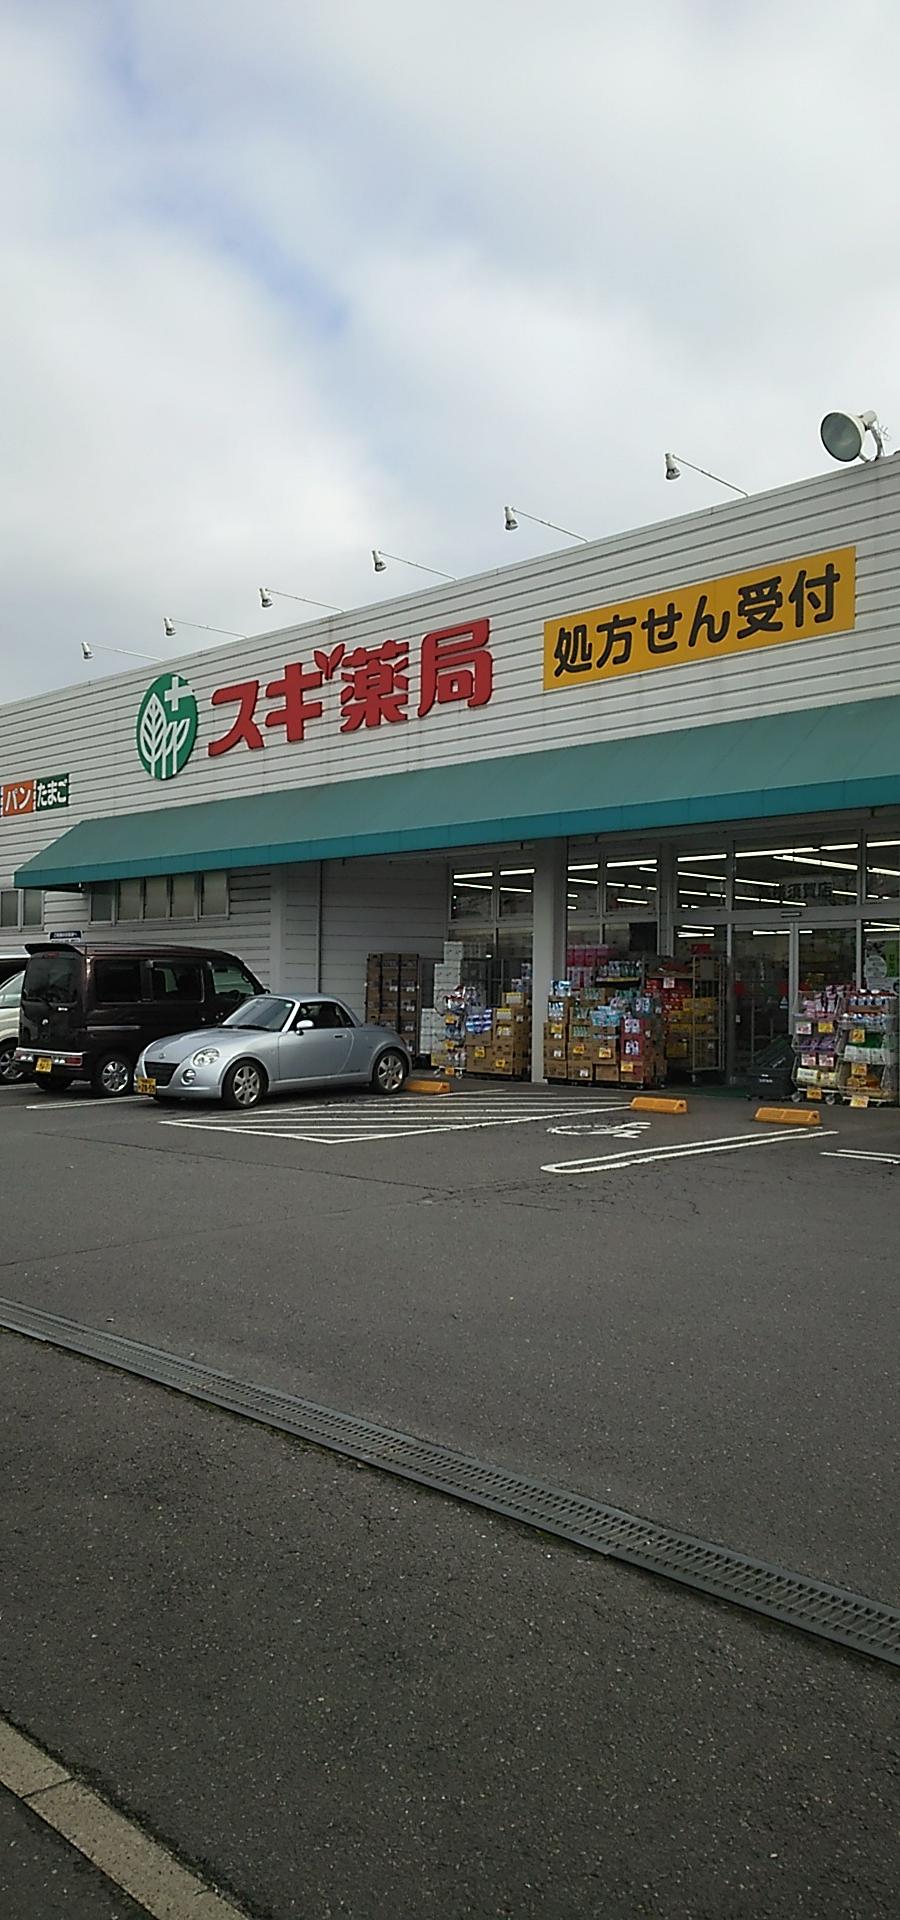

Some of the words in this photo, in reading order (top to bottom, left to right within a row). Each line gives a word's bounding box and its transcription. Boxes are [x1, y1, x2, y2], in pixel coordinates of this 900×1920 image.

[553, 562, 841, 678] 処方せん受付
[207, 618, 493, 757] スギ薬局
[5, 787, 31, 812] パン
[37, 778, 68, 807] たまご
